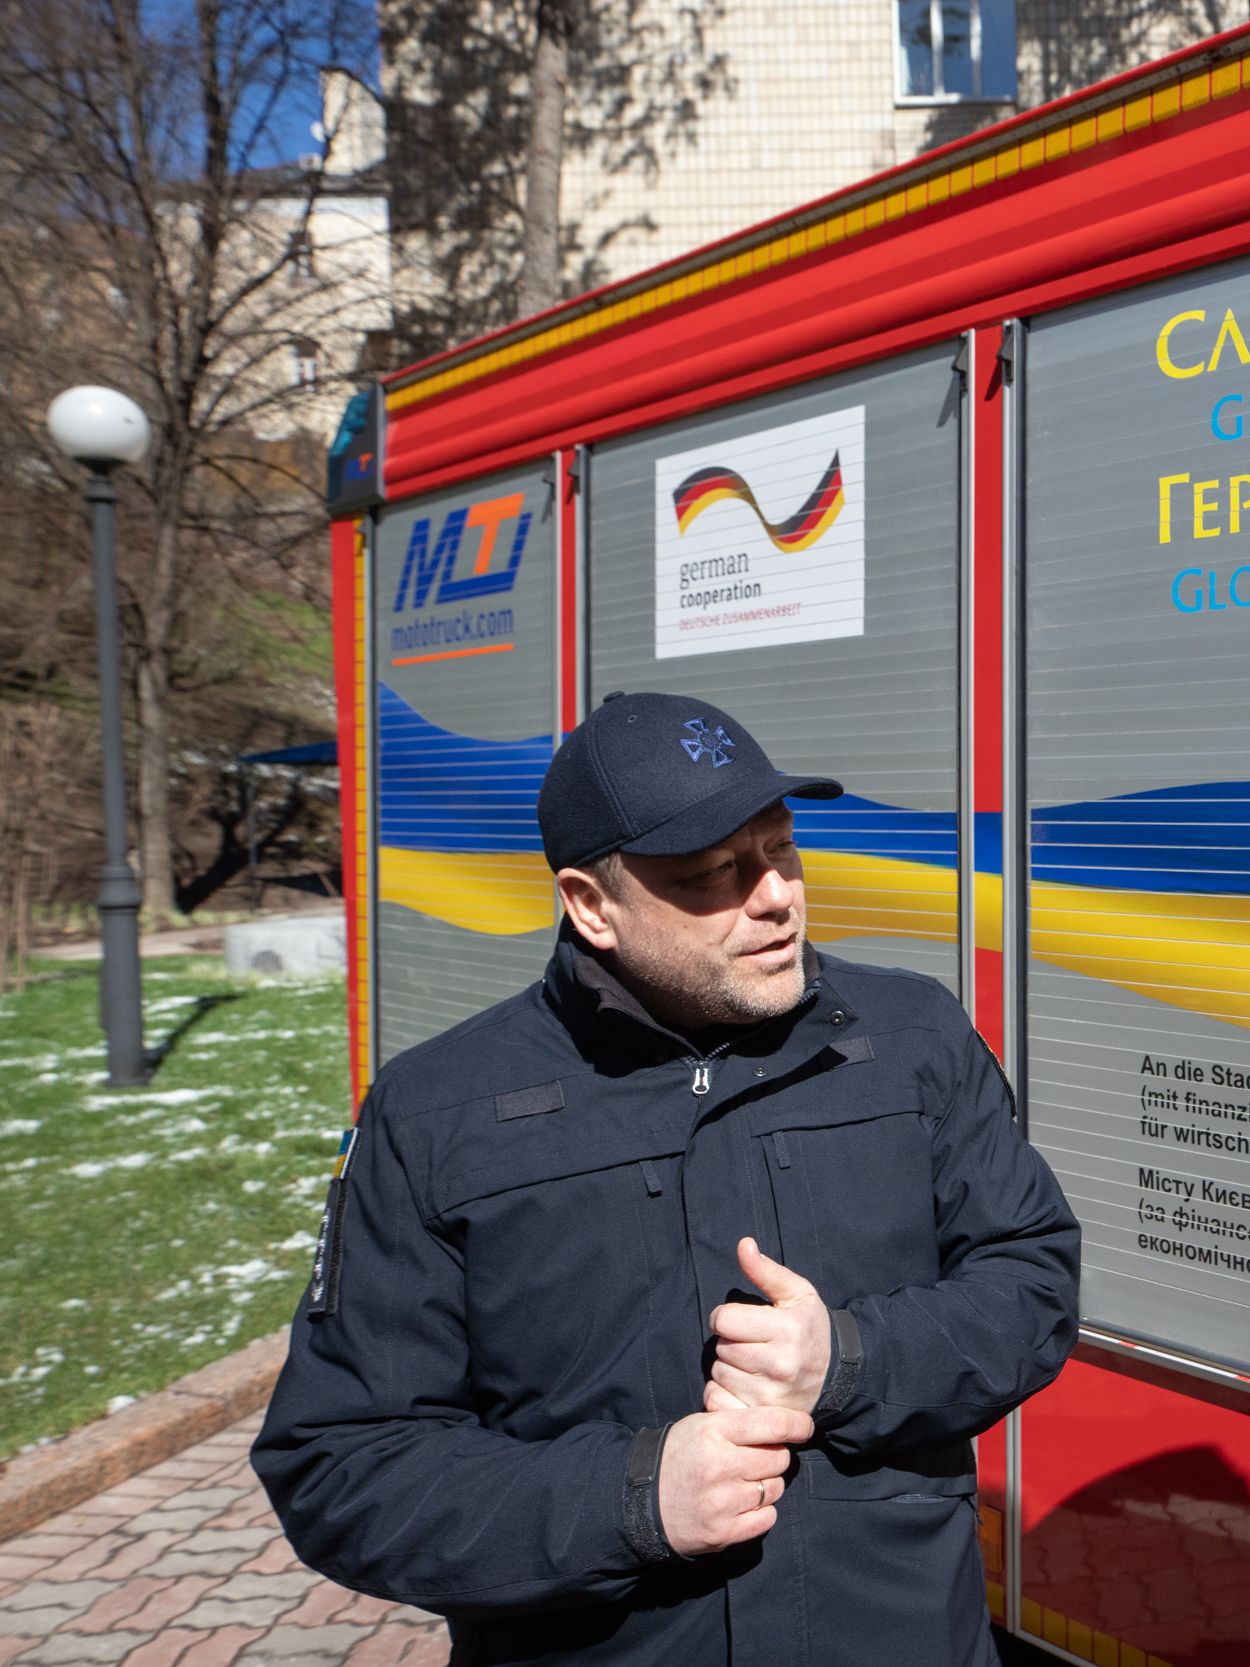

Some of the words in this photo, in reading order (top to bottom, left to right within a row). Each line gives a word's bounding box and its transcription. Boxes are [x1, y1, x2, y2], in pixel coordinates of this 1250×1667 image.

[680, 553, 749, 590] german
[680, 580, 762, 610] cooperation
[392, 609, 514, 650] mototruck.com
[679, 614, 720, 631] DEUTSCHE
[723, 602, 802, 625] ZUSAMMENARBEIT
[1141, 1055, 1167, 1077] An
[1174, 1060, 1204, 1082] die
[1141, 1085, 1178, 1111] (mit
[1140, 1115, 1168, 1138] für
[1139, 1168, 1194, 1202] Місту
[1138, 1198, 1165, 1224] (за
